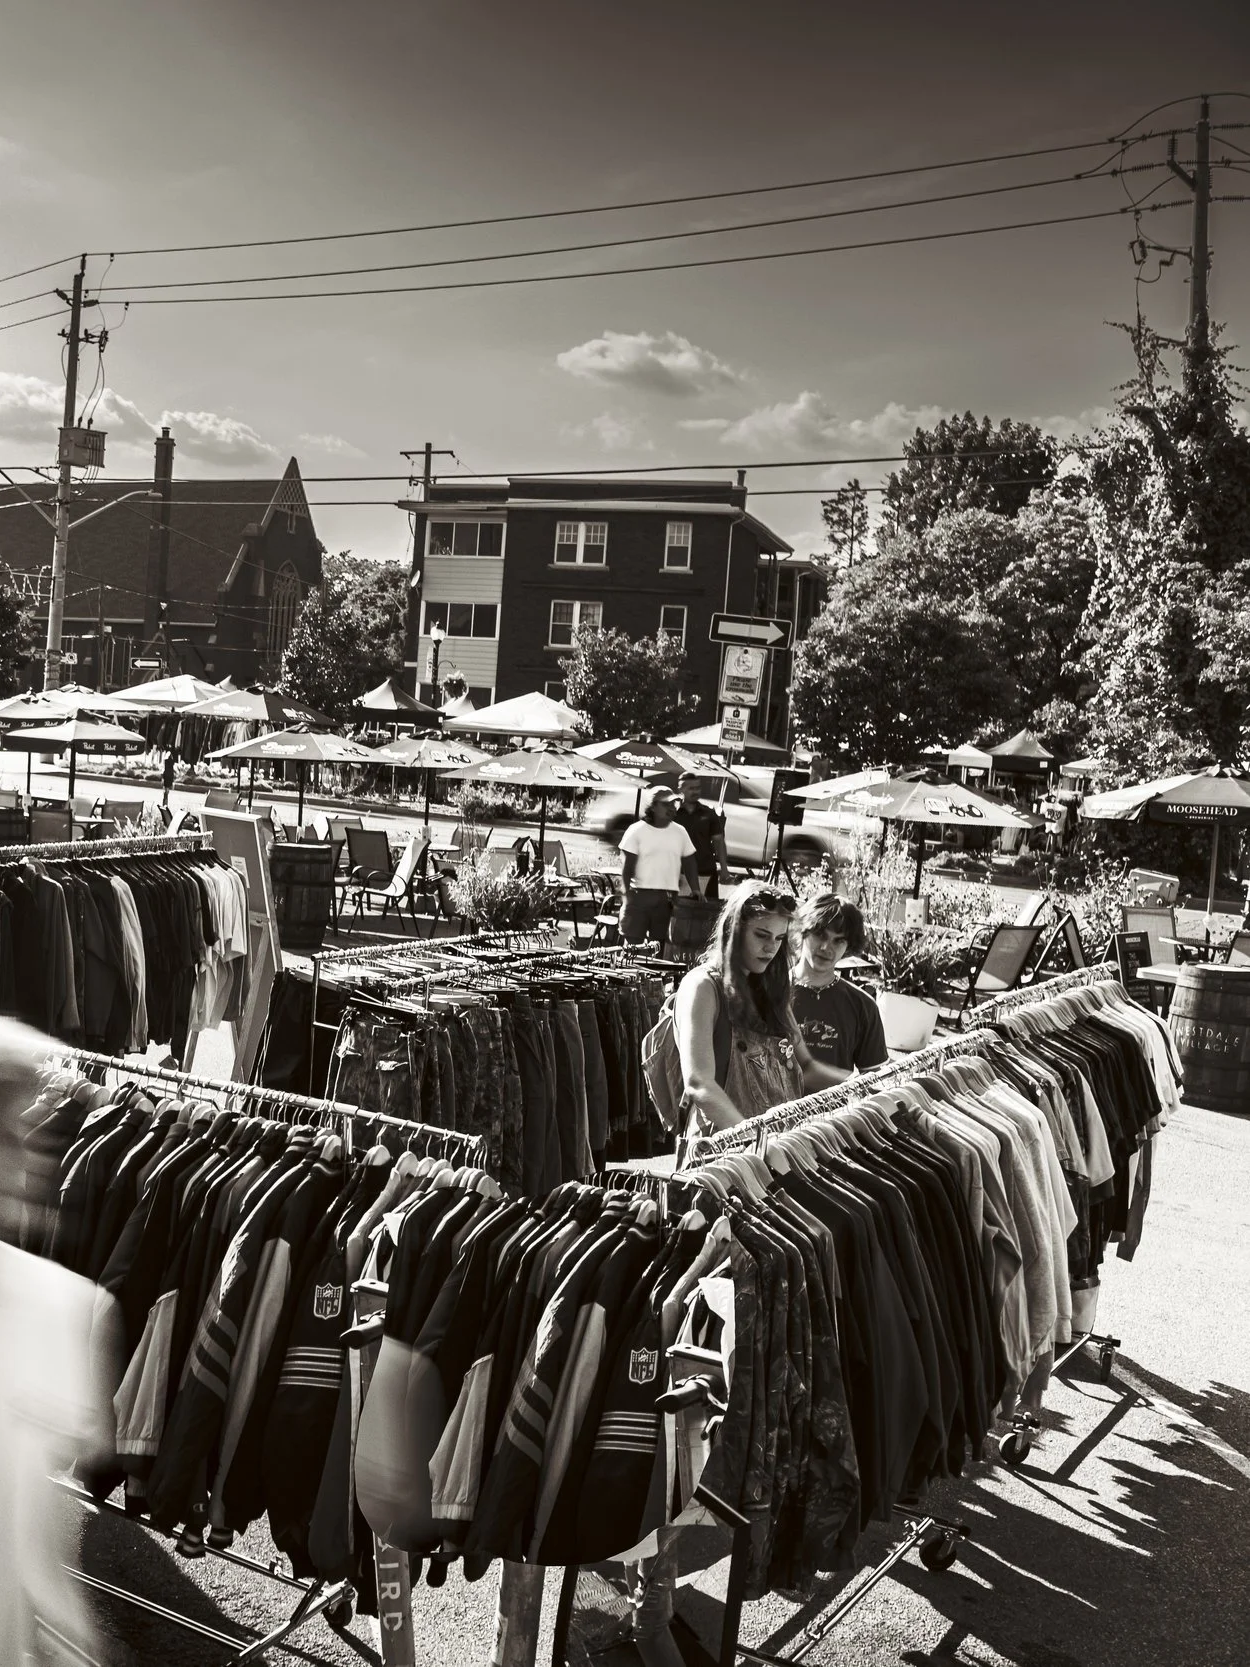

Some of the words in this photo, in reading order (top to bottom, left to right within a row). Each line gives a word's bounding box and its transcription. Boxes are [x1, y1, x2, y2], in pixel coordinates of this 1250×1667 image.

[1166, 805, 1238, 816] MOOSEHEAD
[1176, 1025, 1240, 1048] WESTDALE
[1180, 1037, 1229, 1053] VILLAGE
